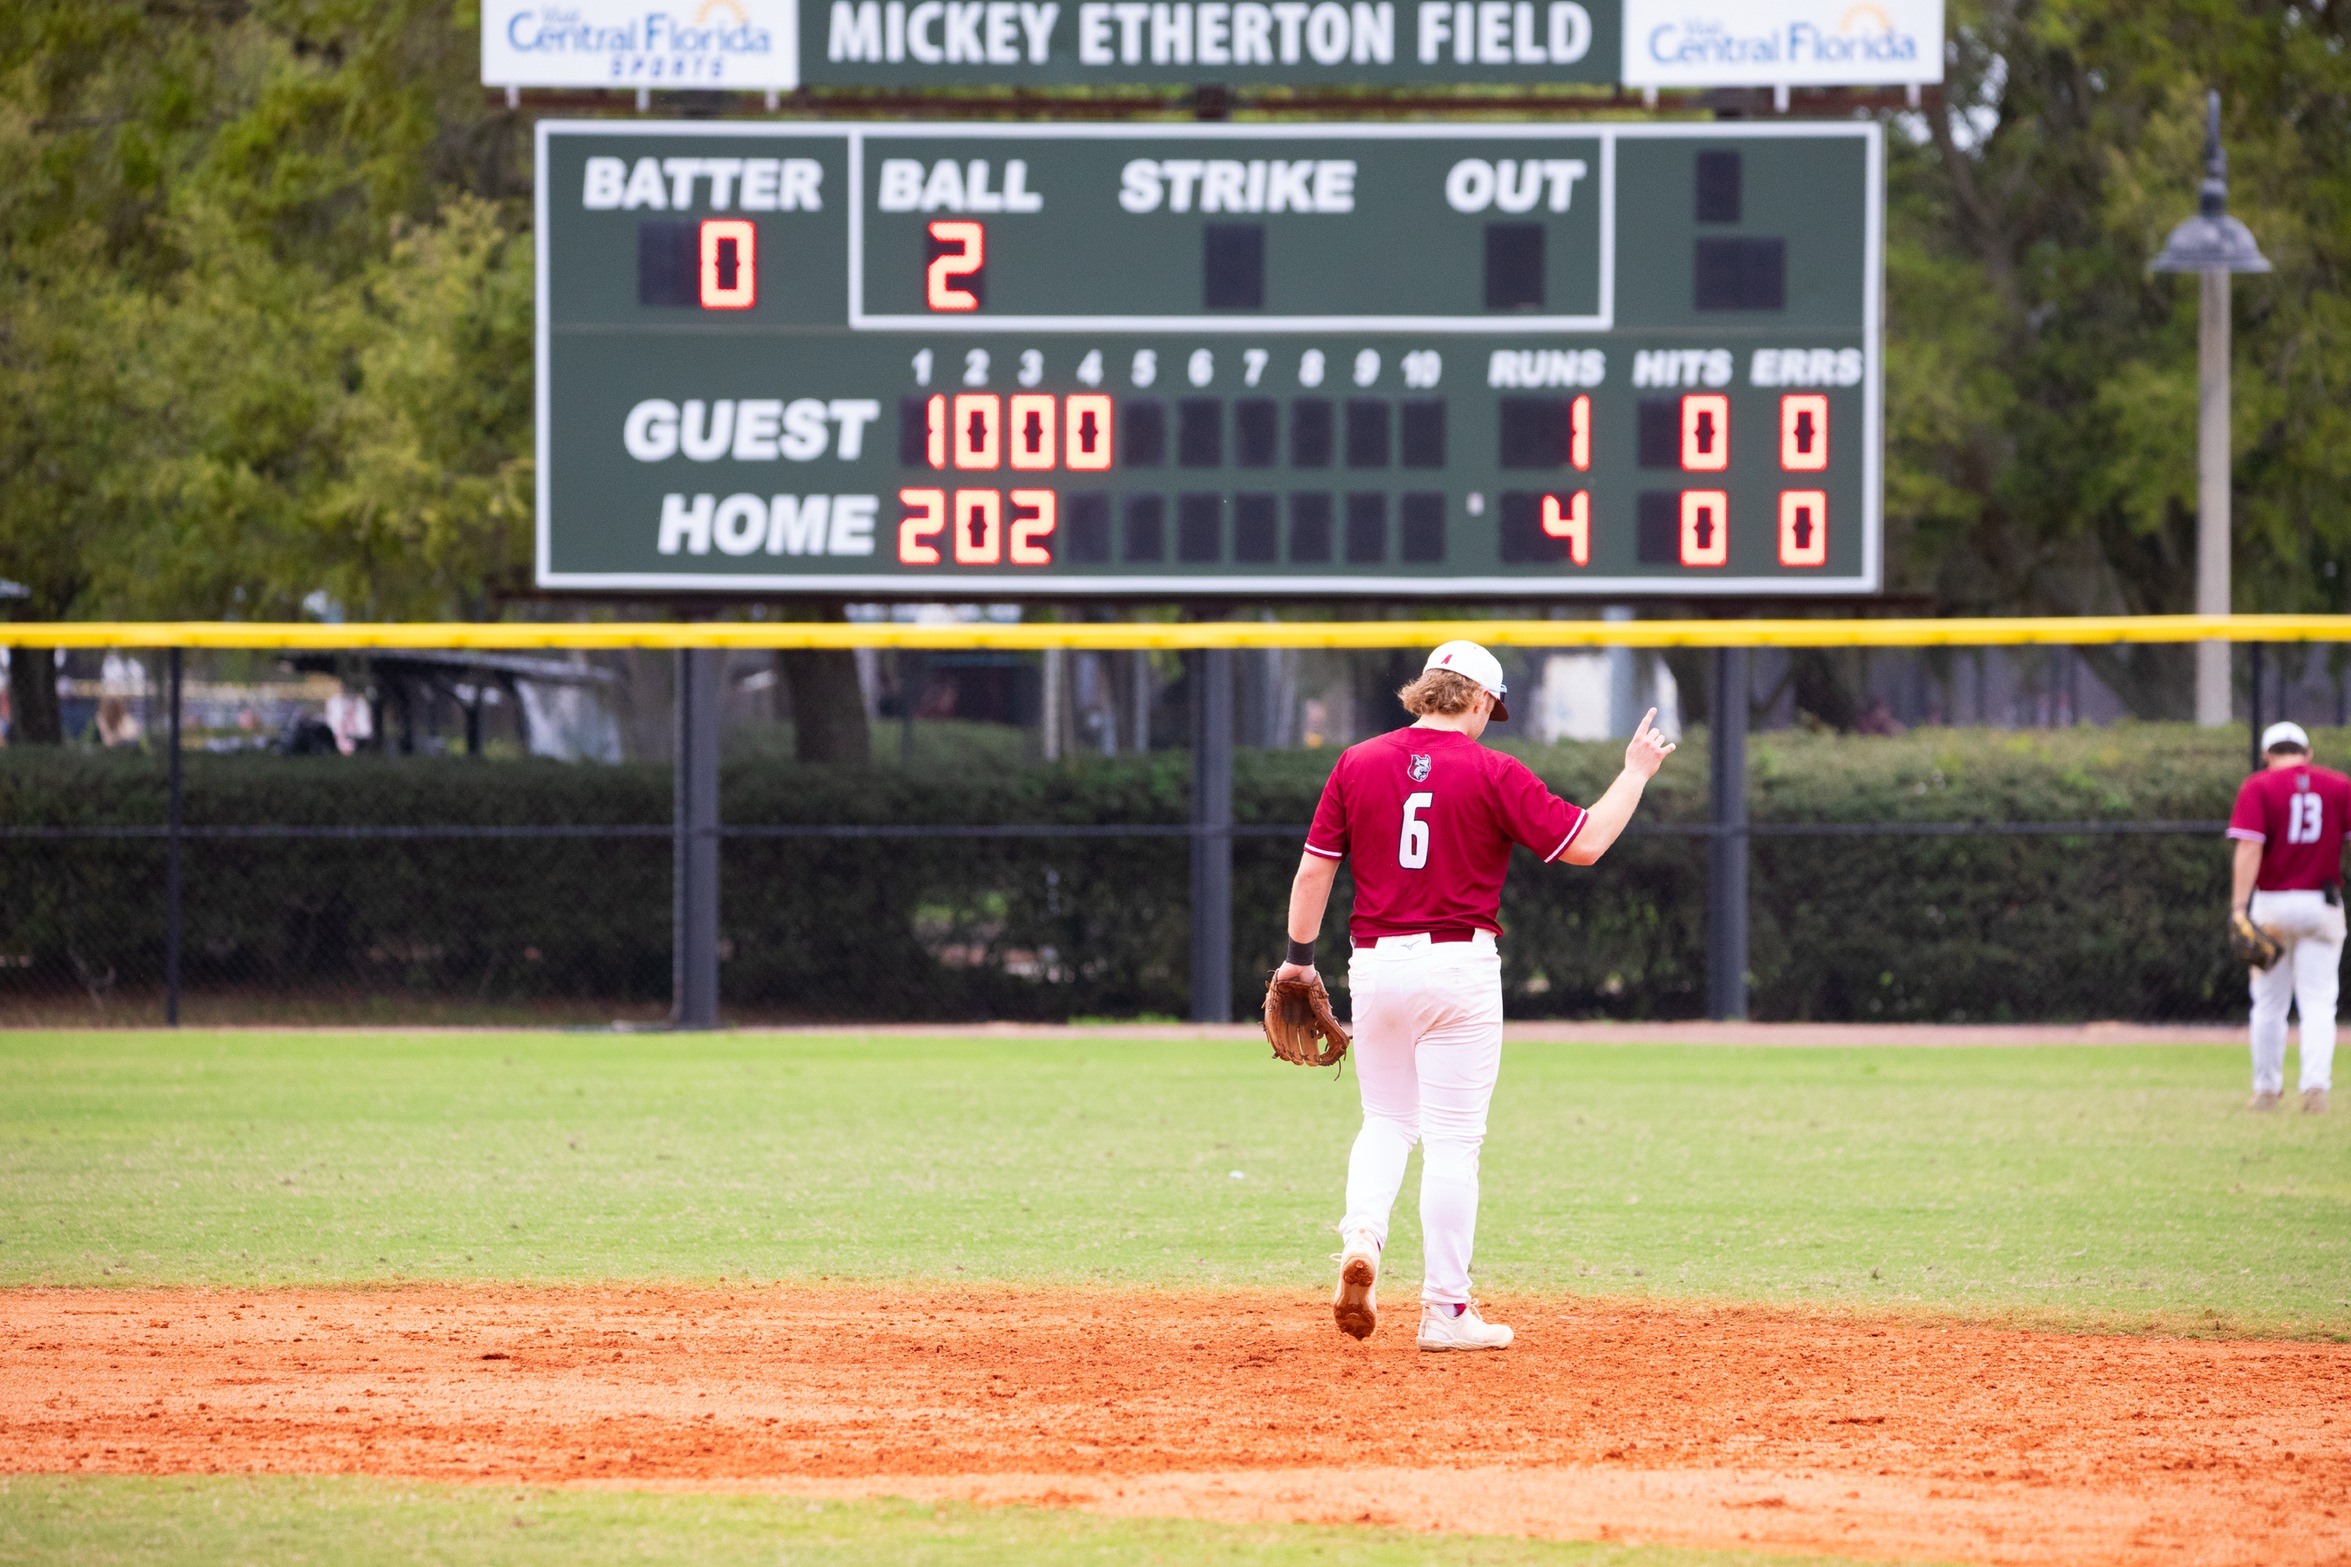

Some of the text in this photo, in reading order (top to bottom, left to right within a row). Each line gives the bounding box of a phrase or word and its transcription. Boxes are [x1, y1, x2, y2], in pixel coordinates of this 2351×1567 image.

[506, 10, 773, 52] Central Florida
[829, 0, 1591, 64] MICKEY ETHERTON FIELD
[1648, 22, 1780, 65] Central
[1787, 22, 1917, 63] Florida
[609, 57, 725, 78] SPORTS
[583, 157, 822, 210] BATTER
[879, 159, 1042, 212] BALL
[1119, 159, 1356, 212] STRIKE
[1446, 159, 1586, 212] OUT
[700, 220, 756, 309] 0
[928, 221, 984, 310] 2
[912, 349, 1441, 387] 1 2 3 4 5 6 7 8 9 10
[1488, 350, 1605, 387] RUNS
[1633, 349, 1732, 386] HITS
[1750, 348, 1863, 386] ERRS
[624, 398, 879, 461] GUEST
[1571, 395, 1590, 471] 1
[1680, 394, 1728, 472] 0
[1780, 394, 1828, 472] 0
[658, 494, 879, 555] HOME
[1542, 490, 1590, 566] 4
[1680, 490, 1728, 566] 0
[1778, 490, 1826, 566] 0
[1400, 791, 1434, 870] 6
[2287, 792, 2323, 844] 13
